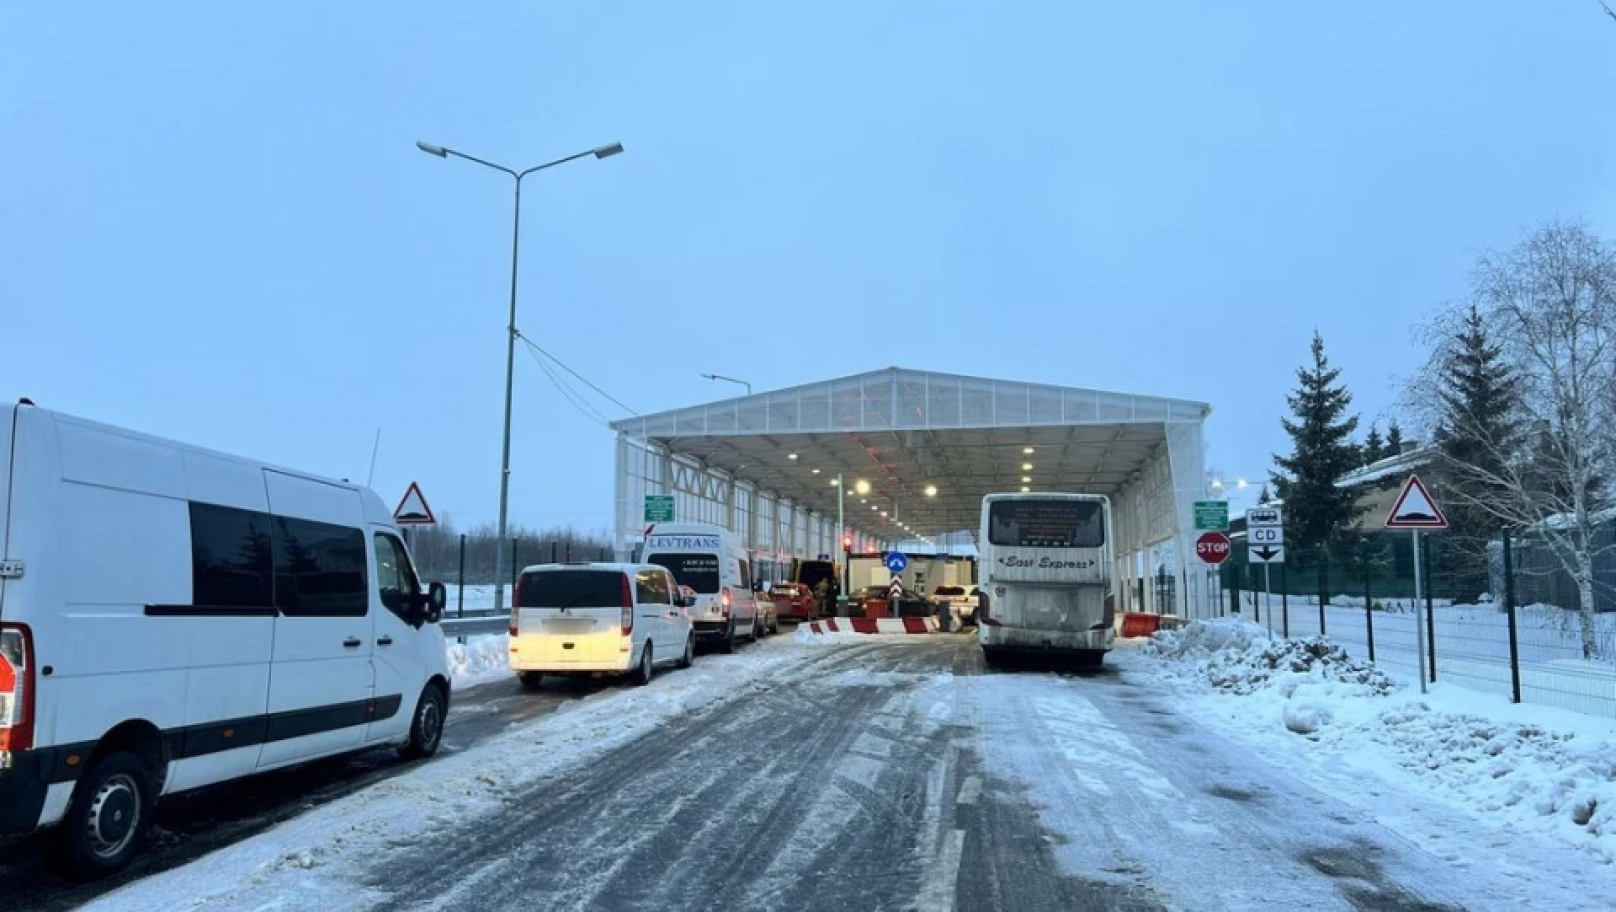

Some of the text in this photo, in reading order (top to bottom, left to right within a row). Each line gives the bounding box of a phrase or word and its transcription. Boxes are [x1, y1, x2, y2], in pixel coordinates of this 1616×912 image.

[1255, 529, 1277, 541] CD
[649, 537, 719, 548] LEVTRANS
[1198, 542, 1228, 553] STOP
[1006, 555, 1087, 569] East Express
